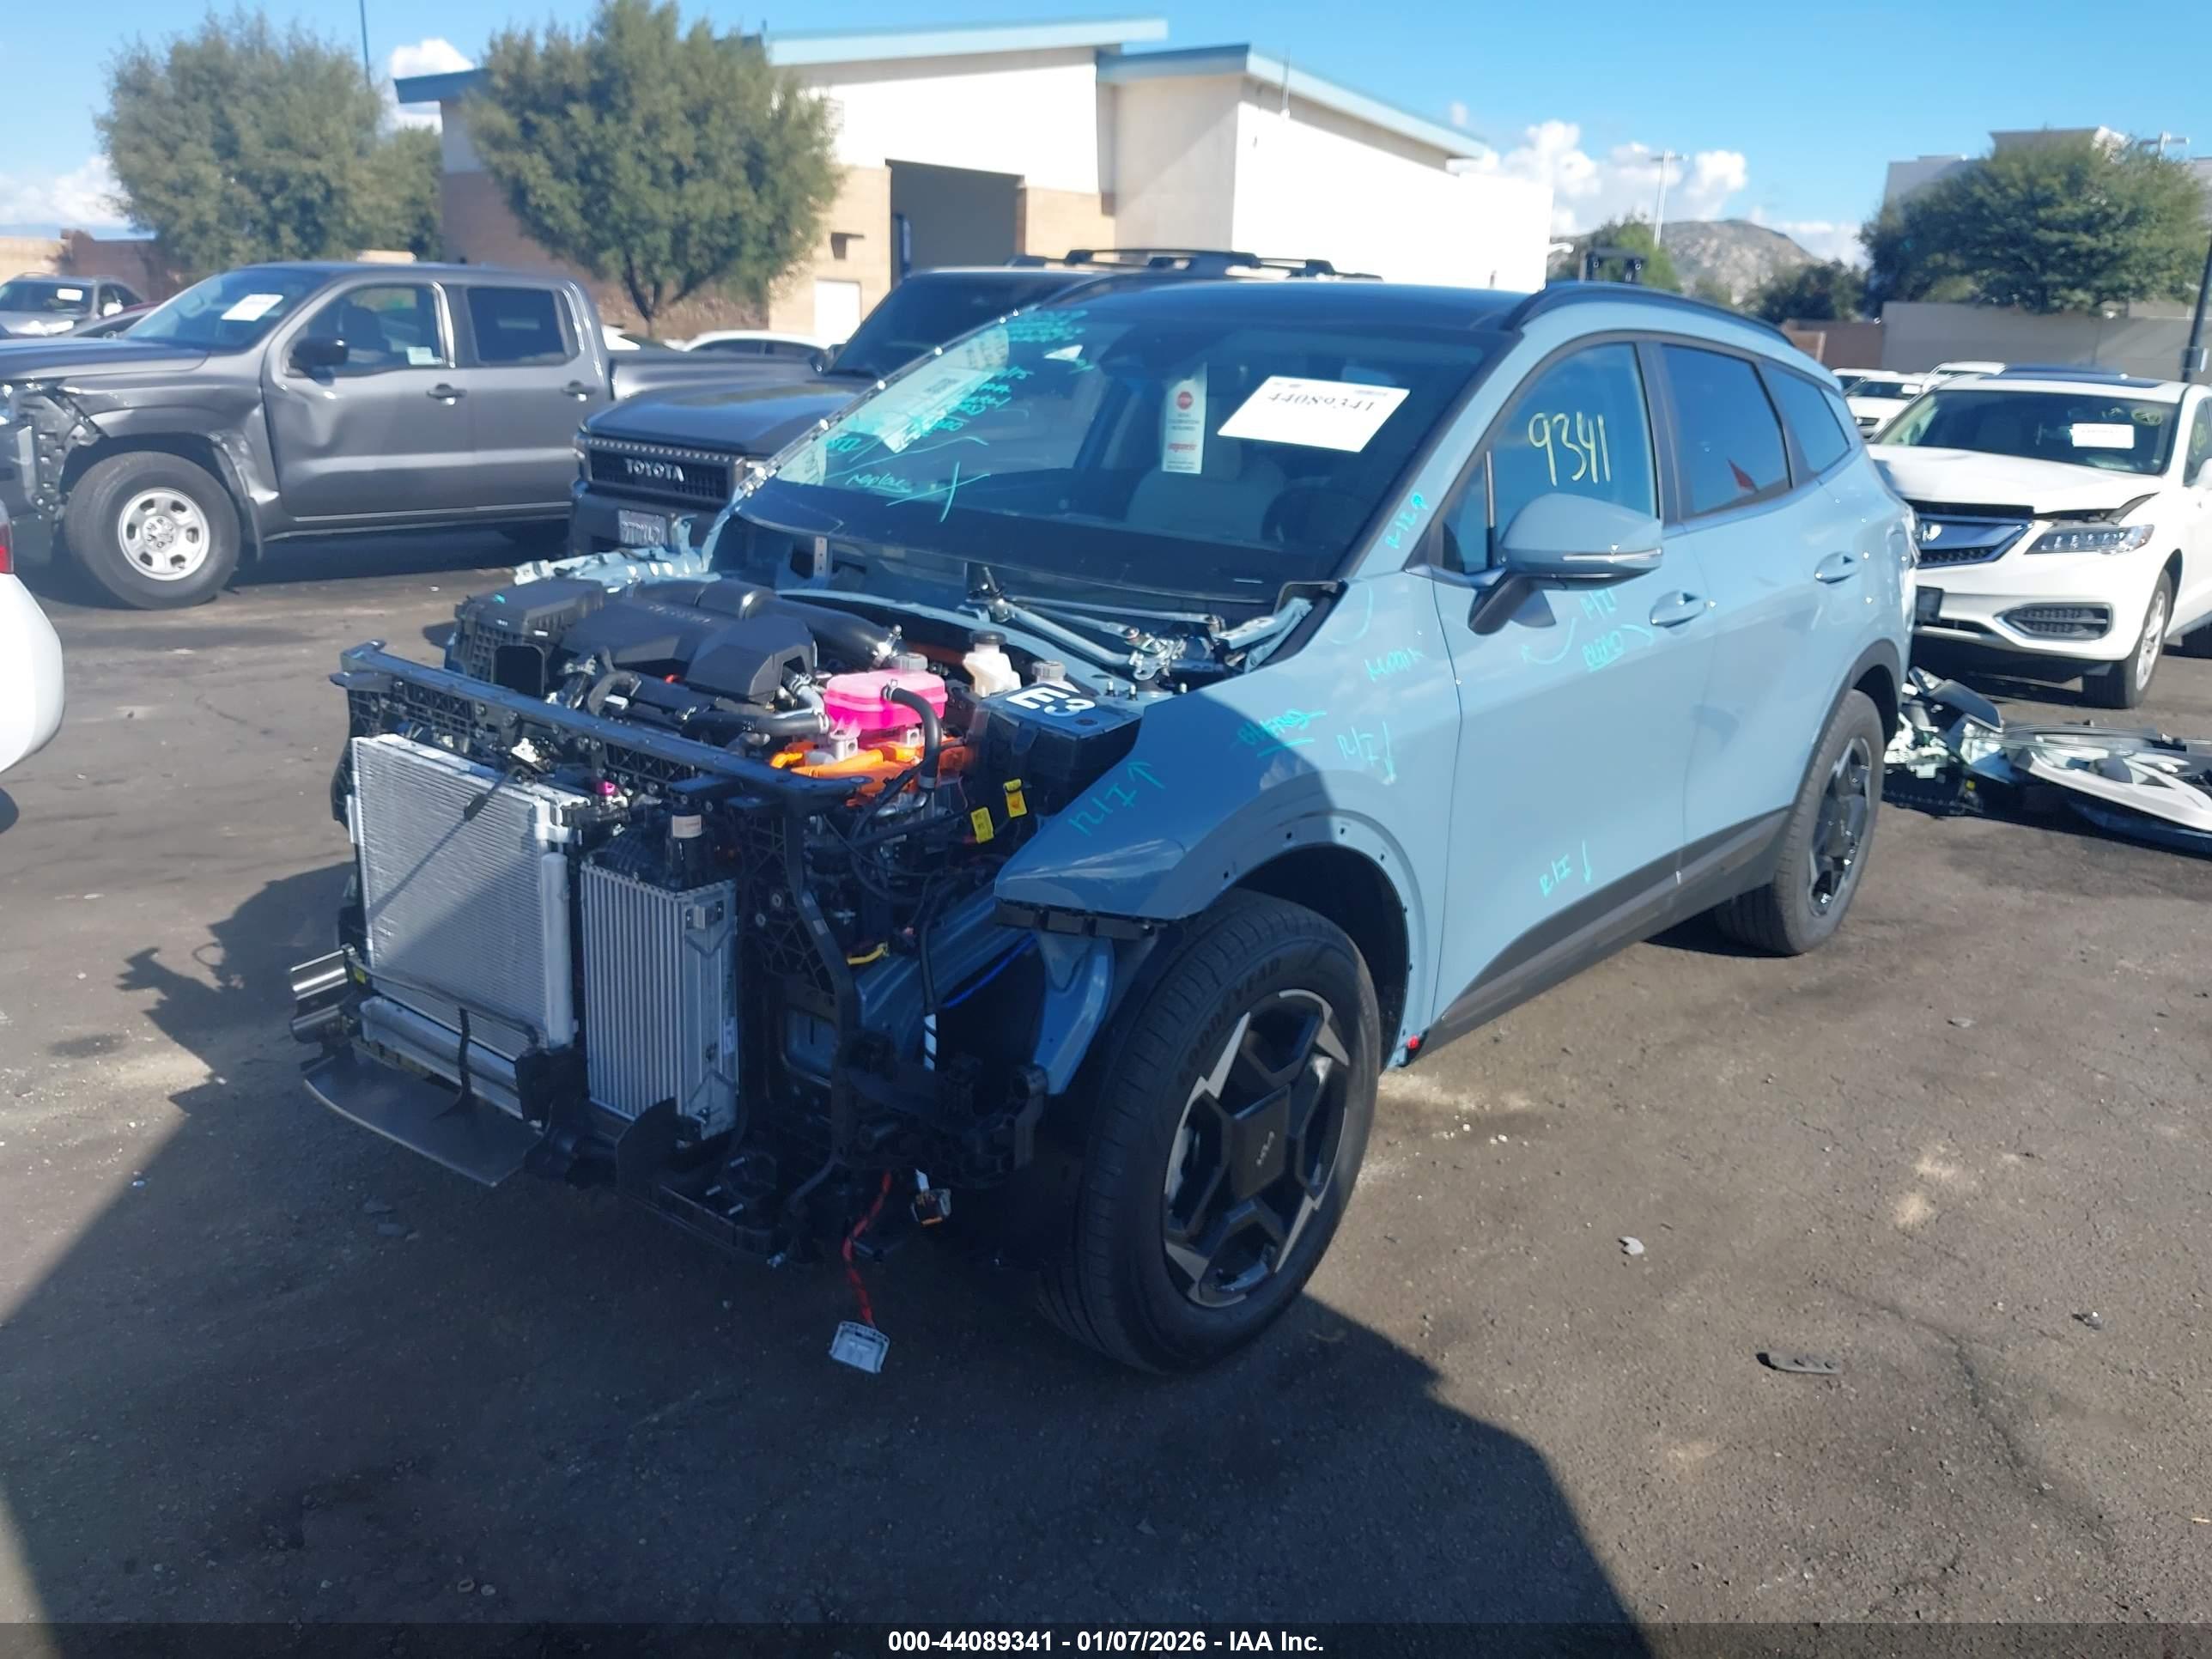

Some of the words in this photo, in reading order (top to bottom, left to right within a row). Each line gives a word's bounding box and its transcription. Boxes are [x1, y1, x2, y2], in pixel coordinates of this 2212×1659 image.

[1268, 391, 1375, 411] 44089341
[1528, 411, 1611, 487] 9341
[624, 458, 684, 483] TOYOTA
